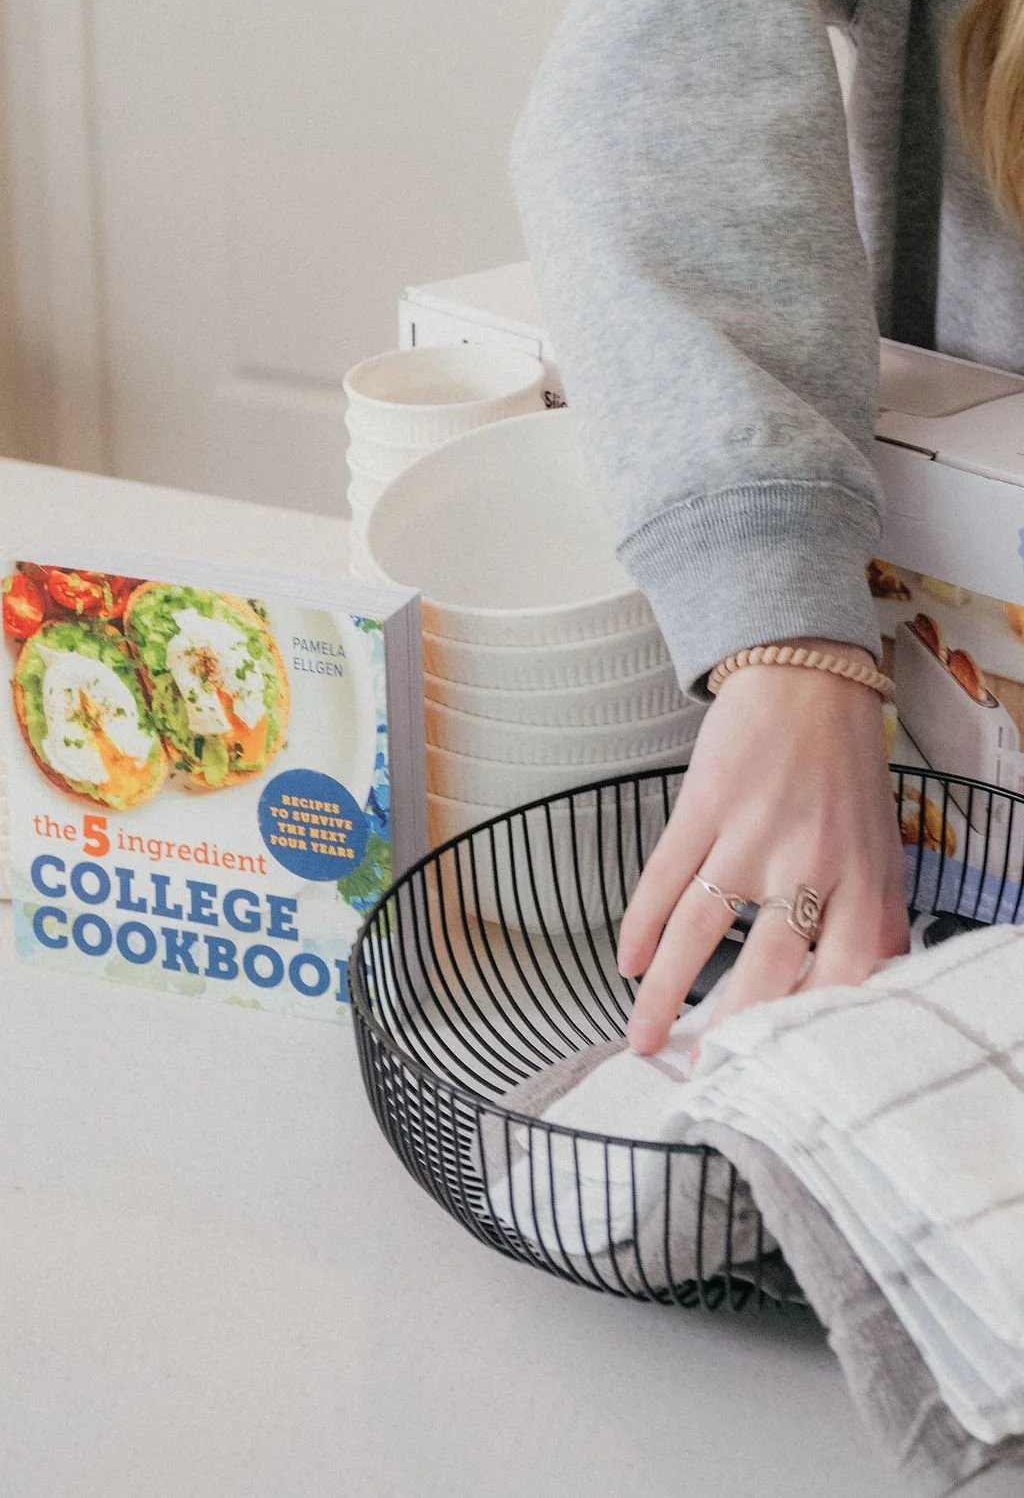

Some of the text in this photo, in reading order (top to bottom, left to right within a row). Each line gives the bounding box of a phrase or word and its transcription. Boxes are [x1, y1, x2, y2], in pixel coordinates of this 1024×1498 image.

[292, 636, 346, 658] PAMELA
[293, 656, 343, 677] ELLGEN
[281, 794, 340, 815] RECIPES
[269, 806, 353, 831] TO SURVIVE
[277, 821, 347, 843] THE NEXT
[33, 814, 267, 876] the 5 ingredient
[269, 834, 355, 859] FOUR YEARS
[30, 853, 299, 942] COLLEGE
